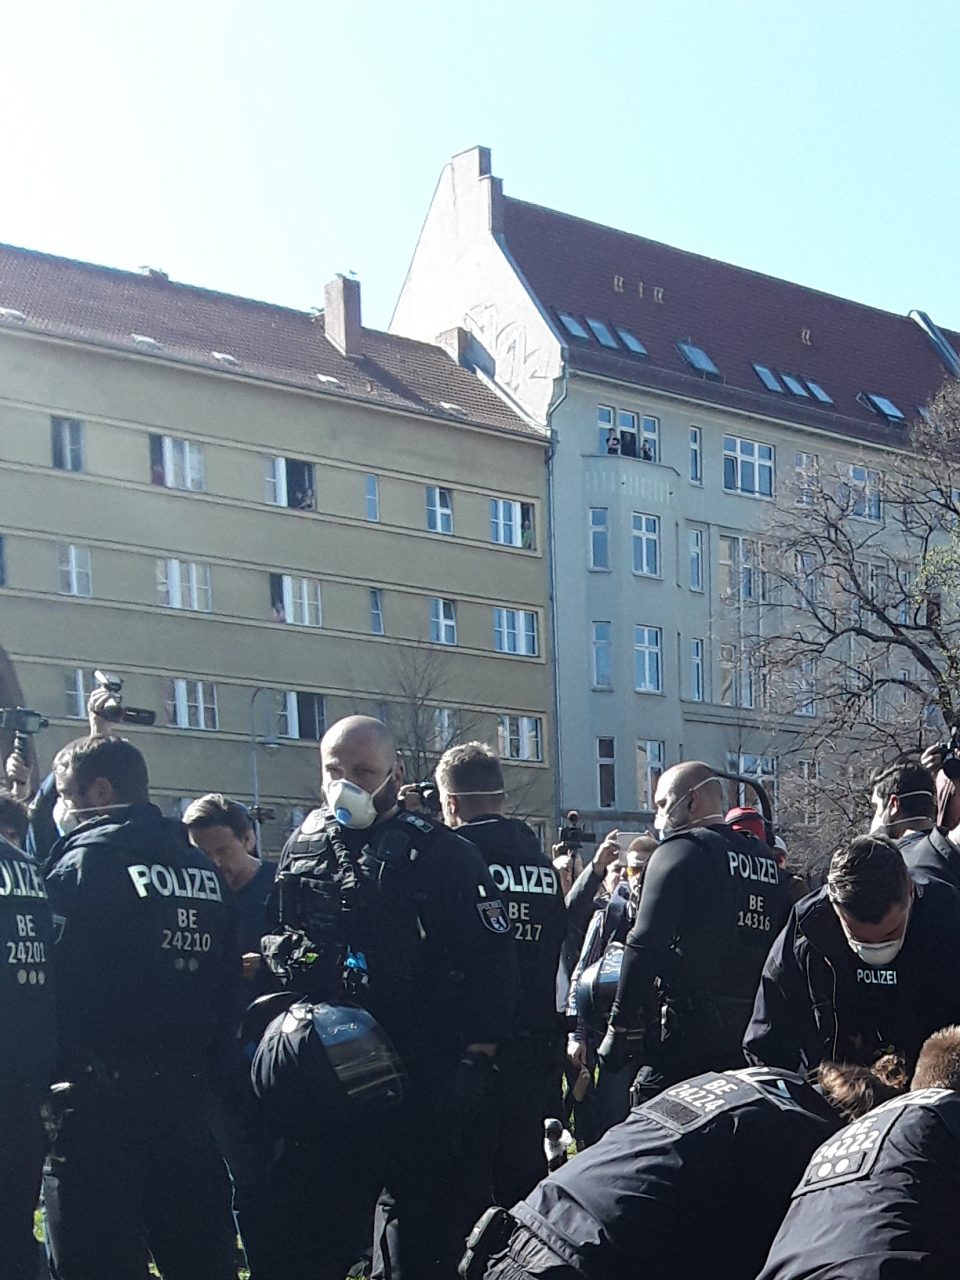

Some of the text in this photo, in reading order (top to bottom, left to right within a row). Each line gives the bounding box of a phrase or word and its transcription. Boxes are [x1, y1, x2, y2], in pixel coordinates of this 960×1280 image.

[727, 851, 779, 885] POLIZEI
[127, 864, 222, 902] POLIZEI
[508, 902, 530, 920] BE
[749, 894, 764, 911] BE
[16, 914, 36, 937] BE
[177, 908, 198, 928] BE
[737, 911, 770, 931] 14316
[161, 929, 211, 952] 24210
[6, 941, 46, 964] 24201
[856, 968, 897, 985] POLIZEI
[667, 1084, 726, 1113] 24224
[702, 1079, 739, 1096] BE
[841, 1117, 878, 1140] BE
[811, 1130, 880, 1166] 24222
